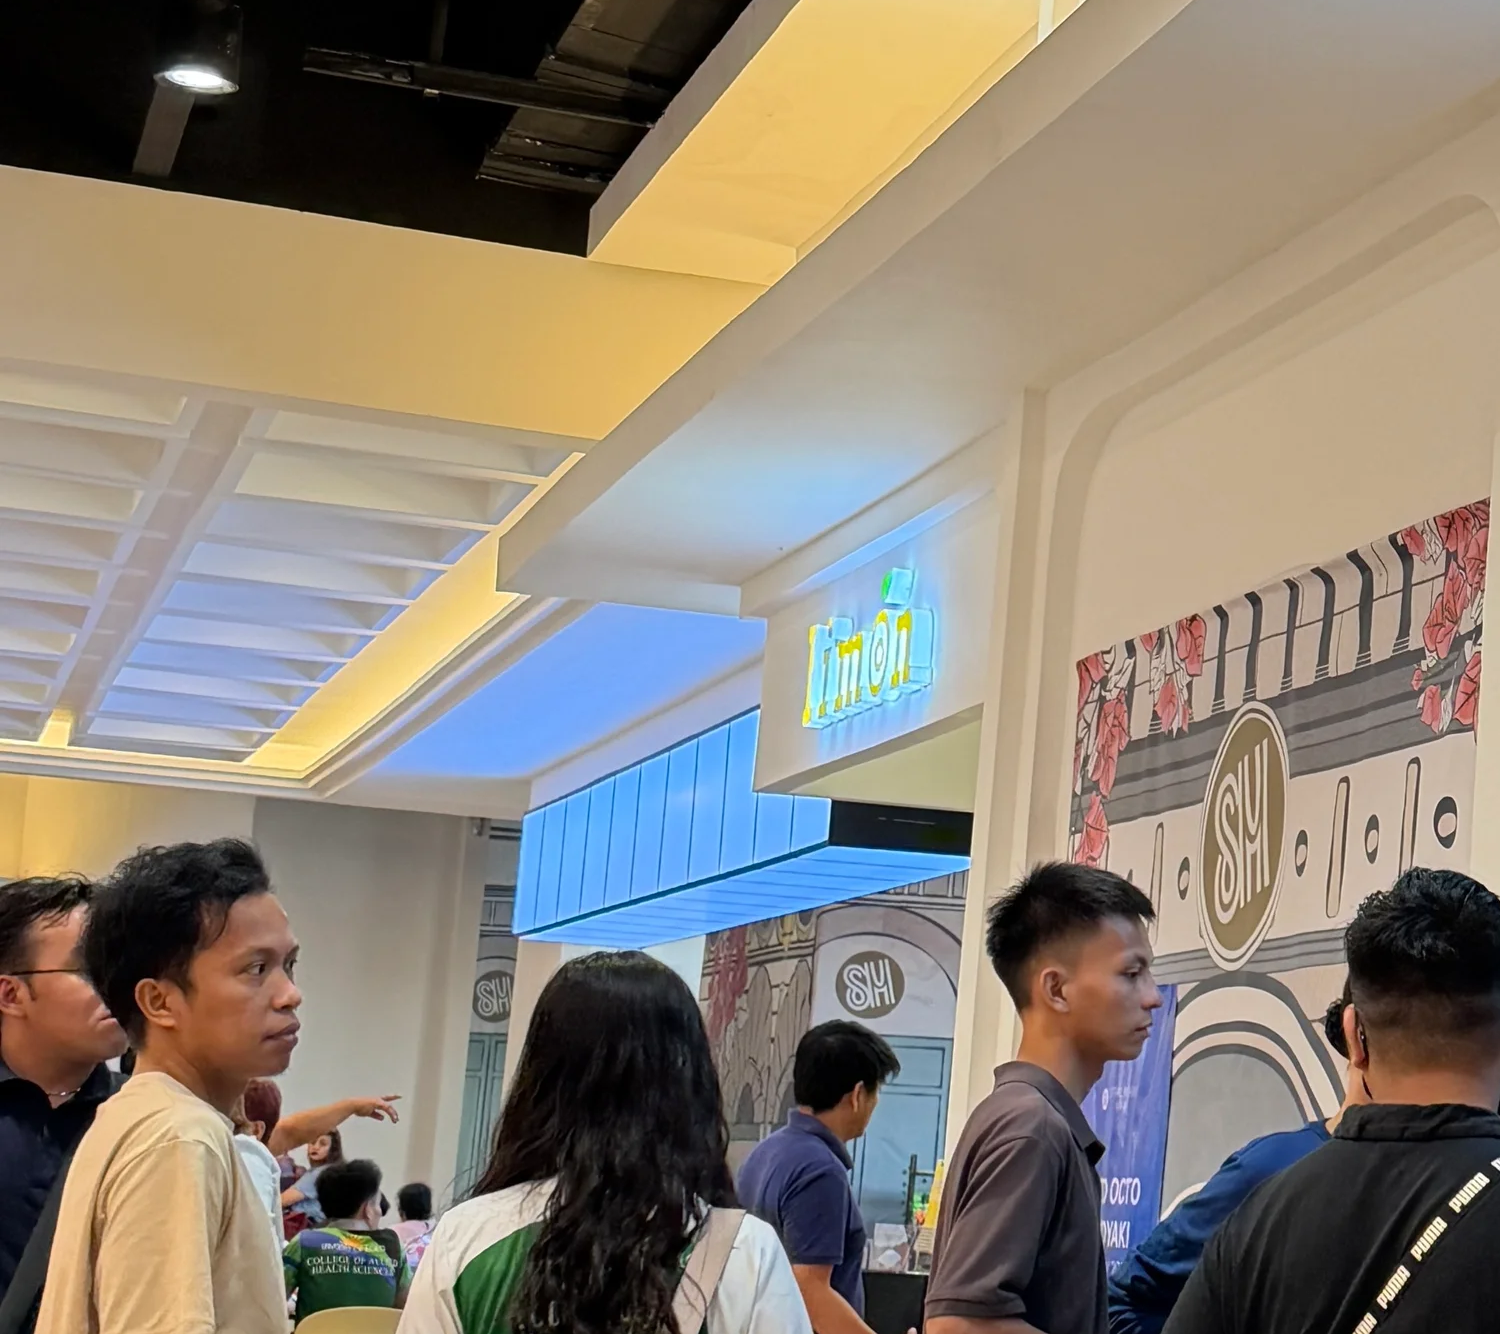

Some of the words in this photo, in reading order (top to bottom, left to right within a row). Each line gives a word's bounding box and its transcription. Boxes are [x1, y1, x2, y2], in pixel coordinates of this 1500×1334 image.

[1214, 737, 1270, 925] SM
[843, 958, 896, 1011] SM
[1109, 1177, 1142, 1206] OCTO
[1376, 1264, 1411, 1310] PUMA
[1410, 1216, 1447, 1261] PUMA
[1448, 1171, 1491, 1214] PUMA
